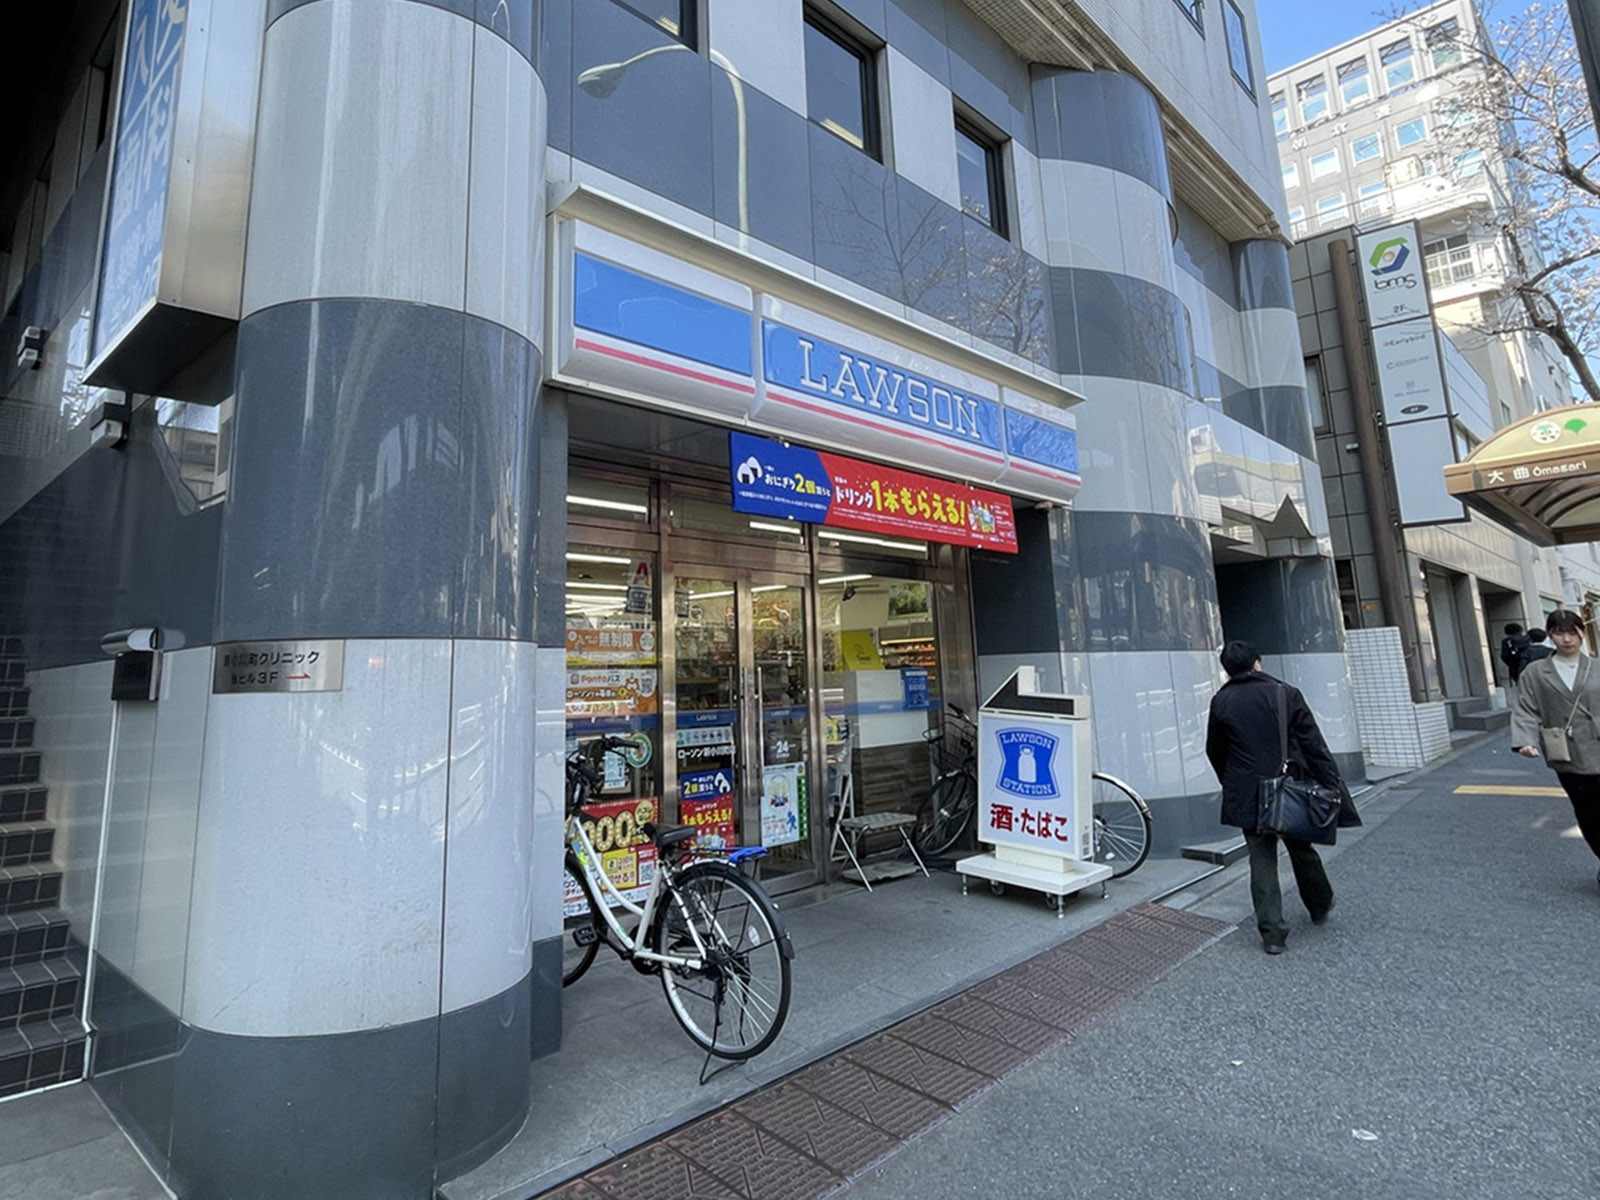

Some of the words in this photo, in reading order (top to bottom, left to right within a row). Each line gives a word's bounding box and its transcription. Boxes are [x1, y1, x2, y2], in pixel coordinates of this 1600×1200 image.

[1374, 273, 1418, 290] bms
[799, 337, 981, 439] LAWSON
[1002, 732, 1053, 750] LAWSON
[1003, 777, 1052, 794] STATION
